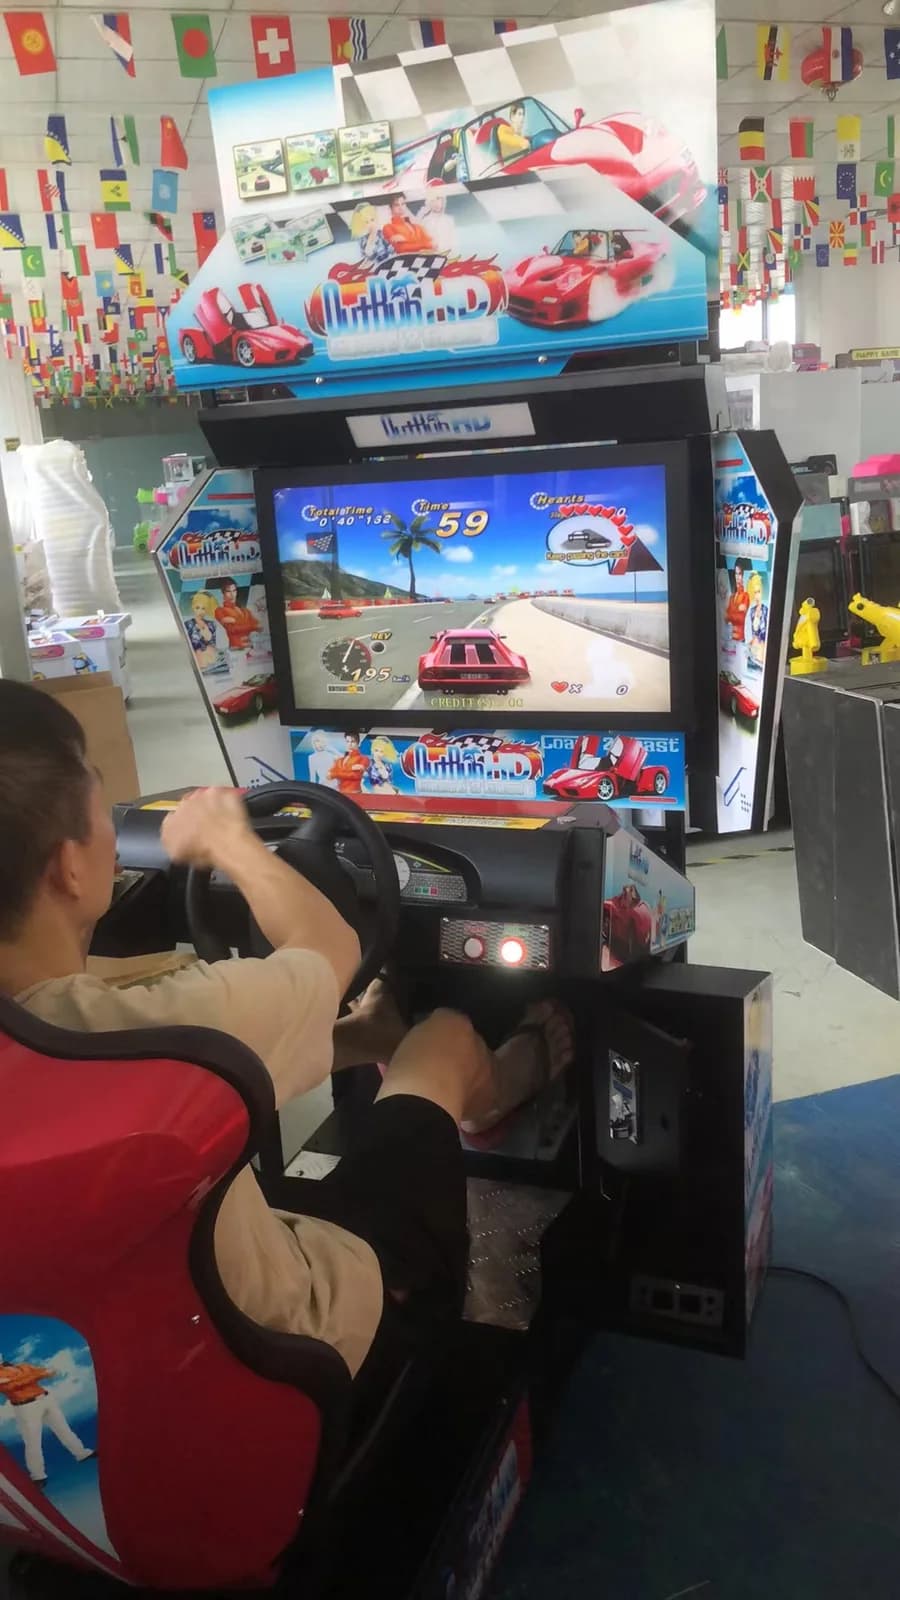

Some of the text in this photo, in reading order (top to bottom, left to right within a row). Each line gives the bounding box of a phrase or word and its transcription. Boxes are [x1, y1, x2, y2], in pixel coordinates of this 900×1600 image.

[423, 276, 490, 325] HD
[536, 494, 586, 505] Hearts
[309, 506, 374, 518] Total Time
[418, 502, 450, 512] Time
[435, 509, 490, 538] 59
[370, 631, 392, 641] REV
[350, 666, 393, 682] 195
[430, 697, 472, 708] CREDIT
[485, 752, 532, 781] HD
